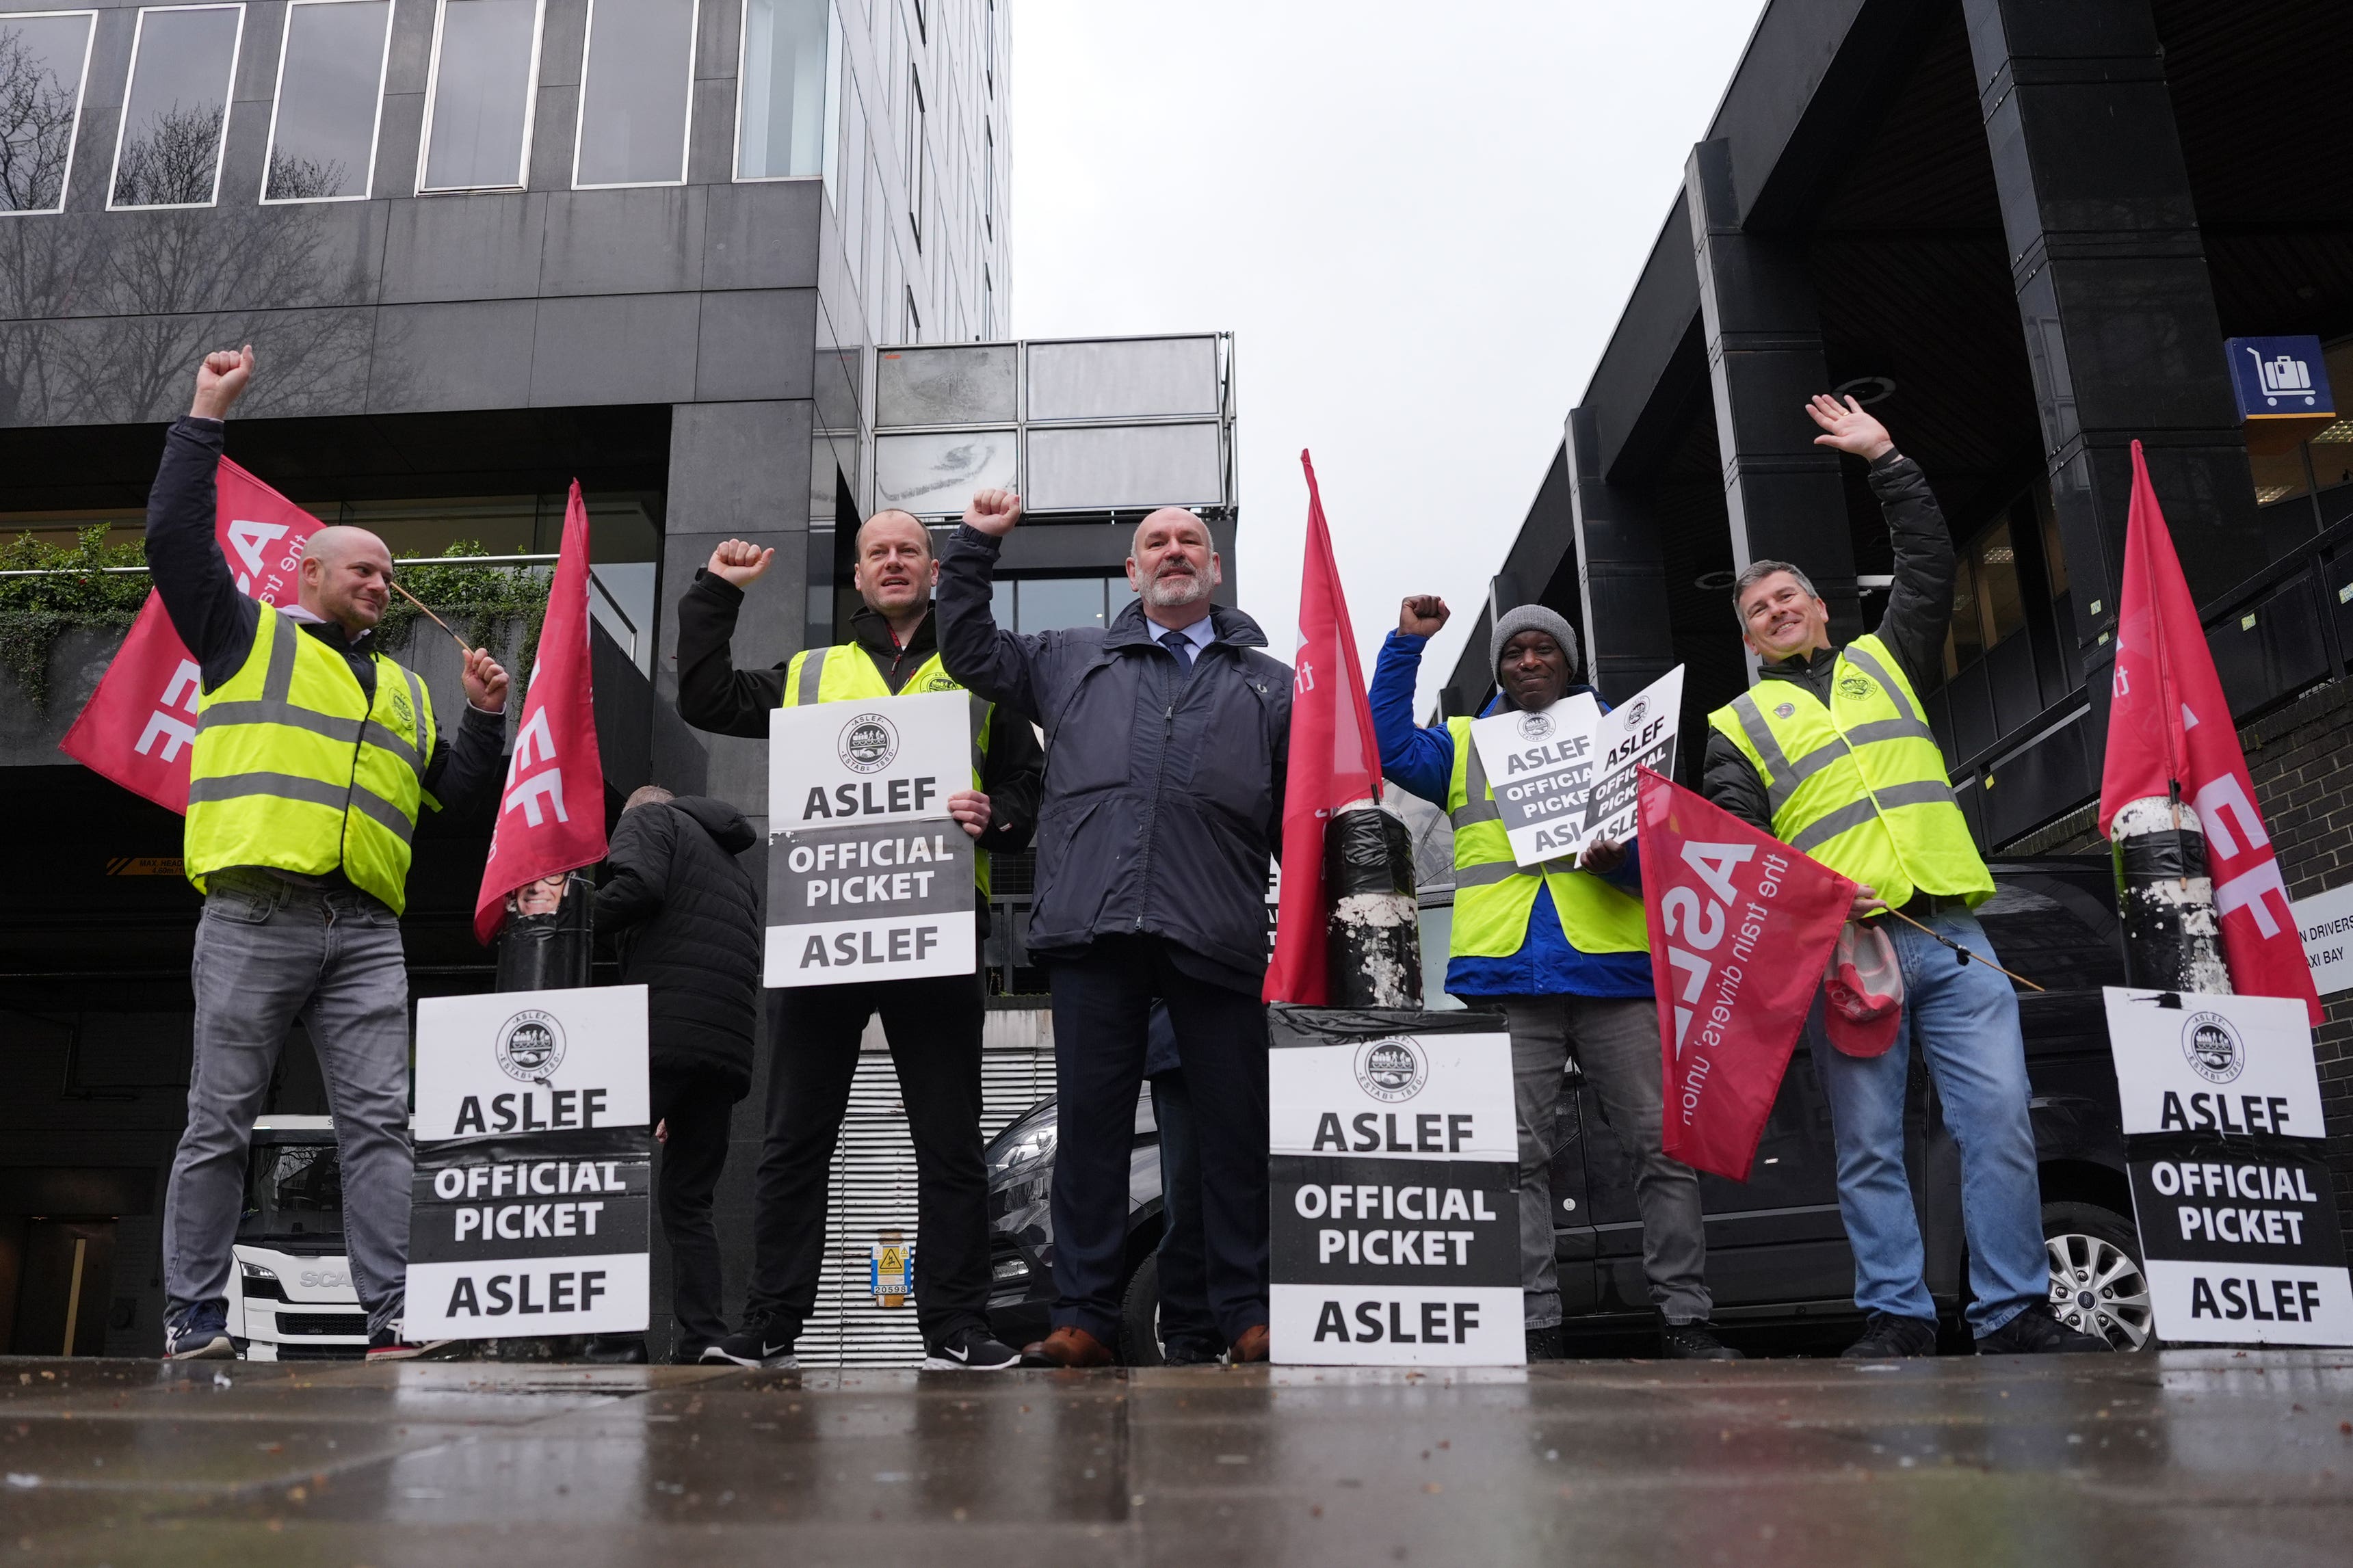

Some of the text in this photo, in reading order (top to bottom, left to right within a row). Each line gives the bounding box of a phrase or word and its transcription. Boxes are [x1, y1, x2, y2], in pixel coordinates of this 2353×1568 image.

[854, 715, 882, 726] ASLEF
[876, 752, 894, 769] 1880
[1508, 735, 1590, 775] ASLEF
[1604, 715, 1664, 772] ASLEF
[802, 777, 936, 820] ASLEF
[1506, 767, 1593, 801] OFFICIA
[1523, 788, 1591, 819] PICKE
[789, 835, 954, 873] OFFICIAL
[806, 871, 934, 907] PICKET
[800, 926, 938, 968] ASLEF
[2323, 946, 2343, 964] BAY
[516, 1012, 547, 1022] ASLEF
[2194, 1014, 2223, 1024] ASLEF
[1402, 1079, 1422, 1098] 1880
[2226, 1061, 2242, 1079] 1880
[453, 1089, 607, 1134] ASLEF
[2161, 1091, 2289, 1135] ASLEF
[1313, 1113, 1473, 1152] ASLEF
[434, 1161, 626, 1199] OFFICIAL
[2152, 1161, 2317, 1202] OFFICIAL
[455, 1201, 604, 1241] PICKET
[1295, 1184, 1497, 1221] OFFICIAL
[2177, 1206, 2303, 1245] PICKET
[1319, 1230, 1474, 1266] PICKET
[300, 1271, 355, 1288] SCA
[446, 1271, 606, 1317] ASLEF
[2192, 1277, 2320, 1323] ASLEF
[1313, 1301, 1480, 1344] ASLEF
